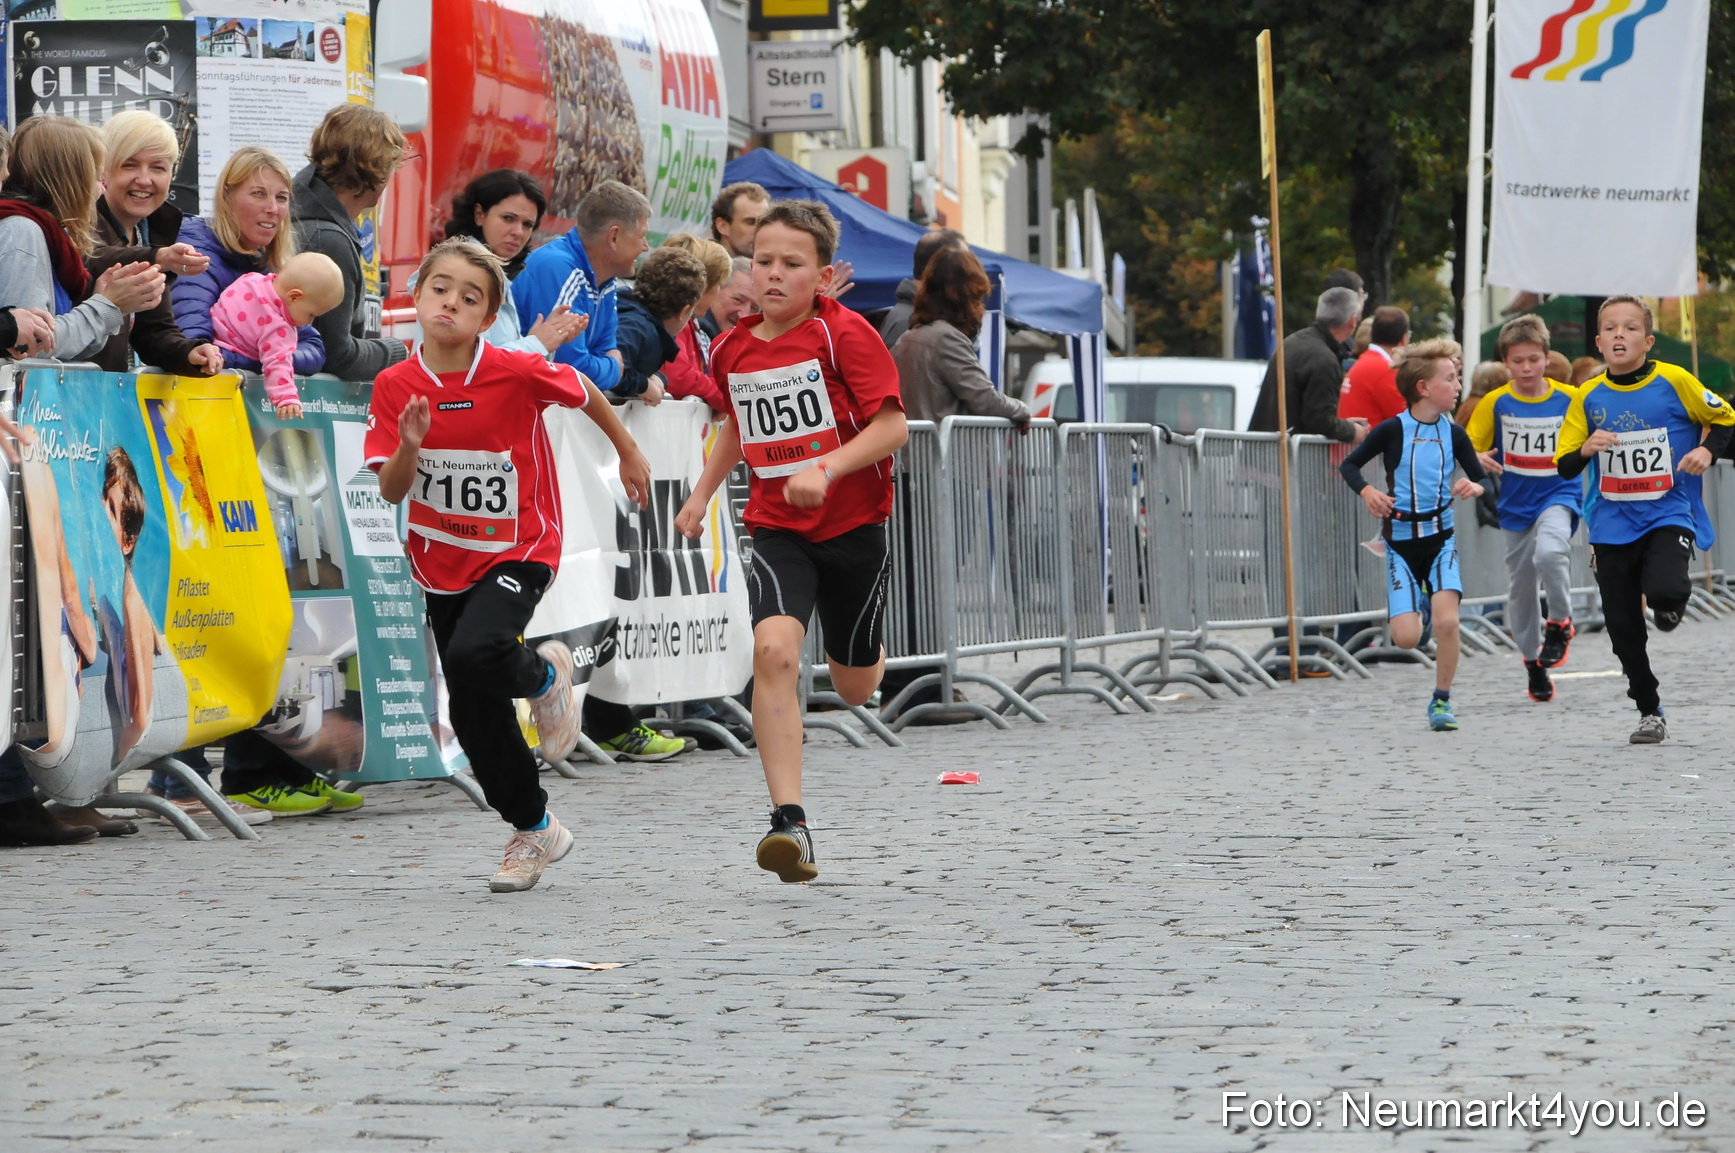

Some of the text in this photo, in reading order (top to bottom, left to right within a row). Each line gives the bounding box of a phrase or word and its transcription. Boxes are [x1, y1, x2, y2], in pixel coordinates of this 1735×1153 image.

[31, 49, 107, 59] THE WORLD FAMOUS
[31, 65, 175, 98] GLENN
[288, 73, 301, 84] für
[767, 68, 825, 87] Stern
[1506, 182, 1690, 202] stadtwerke neumarkt
[756, 376, 803, 392] Neumarkt
[28, 389, 62, 424] Mein
[738, 389, 823, 437] 7050
[1508, 431, 1556, 453] 7141
[1620, 437, 1655, 446] Neumarkt
[765, 445, 805, 462] Kilian
[1604, 447, 1664, 474] 7162
[442, 460, 497, 471] Neumarkt
[417, 466, 507, 513] 7163
[1617, 481, 1650, 491] Lorenz
[346, 491, 375, 509] MATHI
[218, 500, 258, 533] KAIN
[440, 517, 478, 536] Linus
[177, 577, 210, 597] Pflaster
[171, 608, 235, 632] Außenplatten
[572, 645, 594, 668] die
